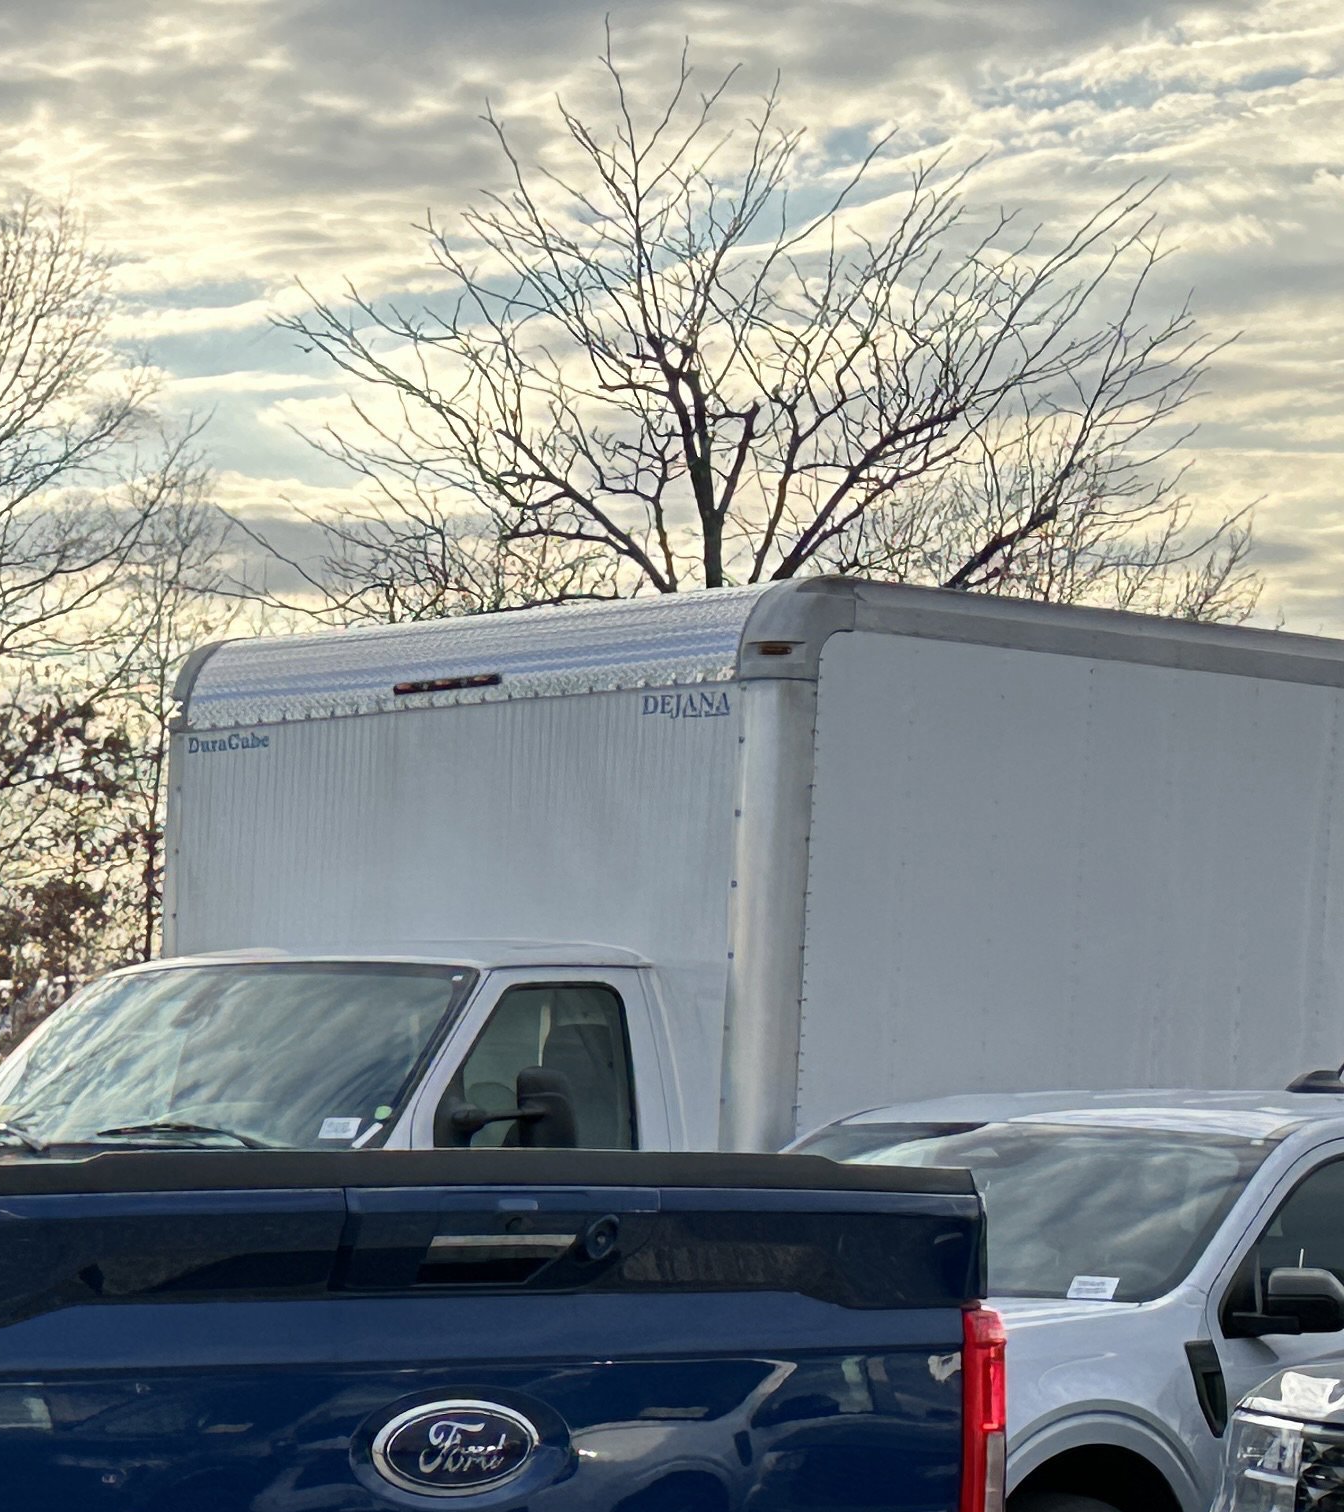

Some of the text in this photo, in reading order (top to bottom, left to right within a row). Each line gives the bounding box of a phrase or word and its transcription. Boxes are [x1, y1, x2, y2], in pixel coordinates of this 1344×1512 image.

[642, 692, 730, 720] DEJANA
[188, 732, 270, 754] DuraCube
[418, 1420, 507, 1474] Ford
